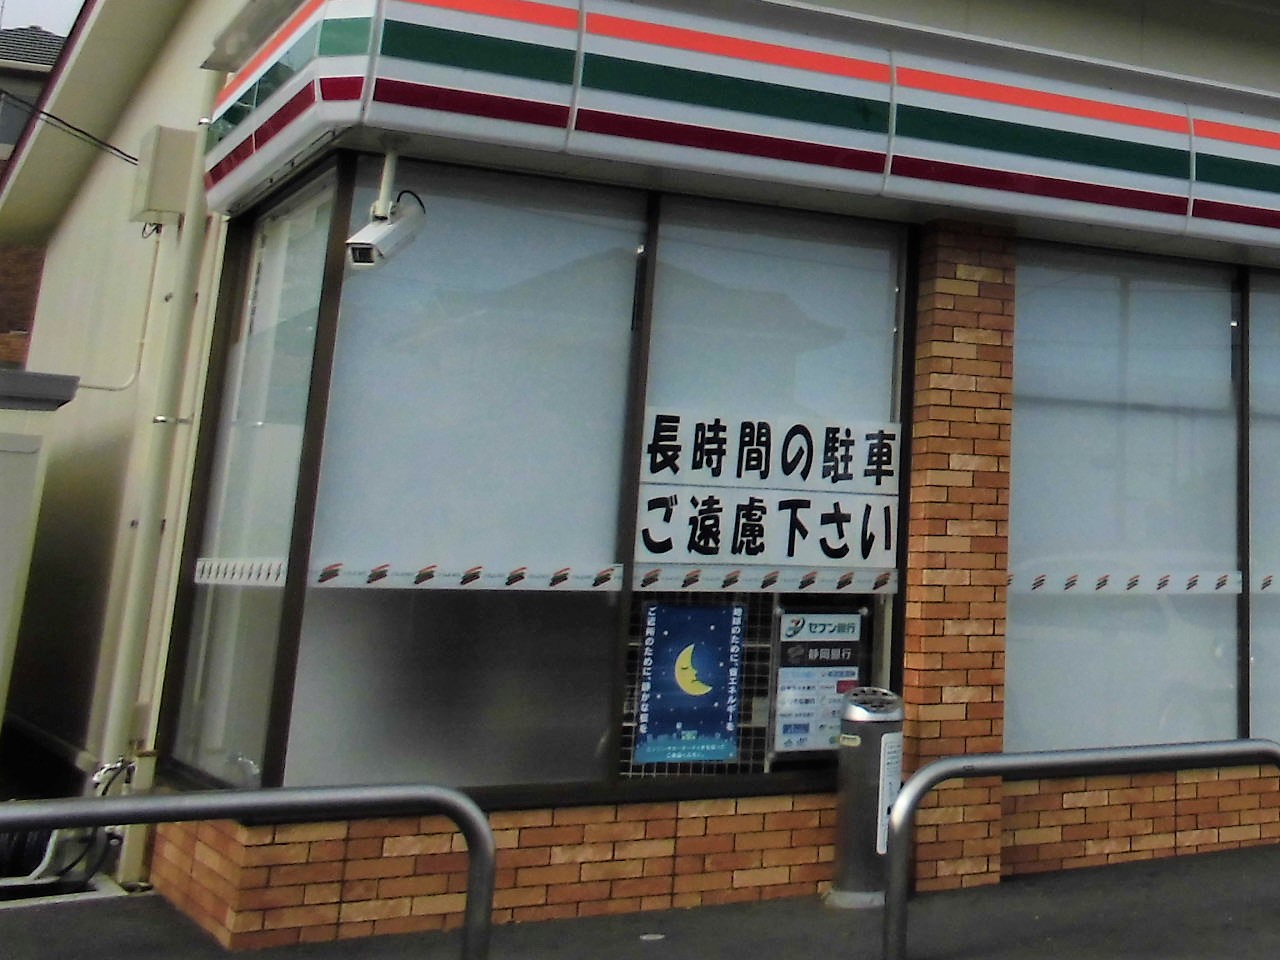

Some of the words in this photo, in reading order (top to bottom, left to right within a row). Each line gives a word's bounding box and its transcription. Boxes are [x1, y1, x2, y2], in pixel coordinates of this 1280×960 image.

[647, 414, 895, 486] 長時間の駐車
[641, 494, 893, 560] ご遠慮下さい
[809, 622, 856, 635] セブン銀行
[808, 648, 852, 661] 静岡銀行
